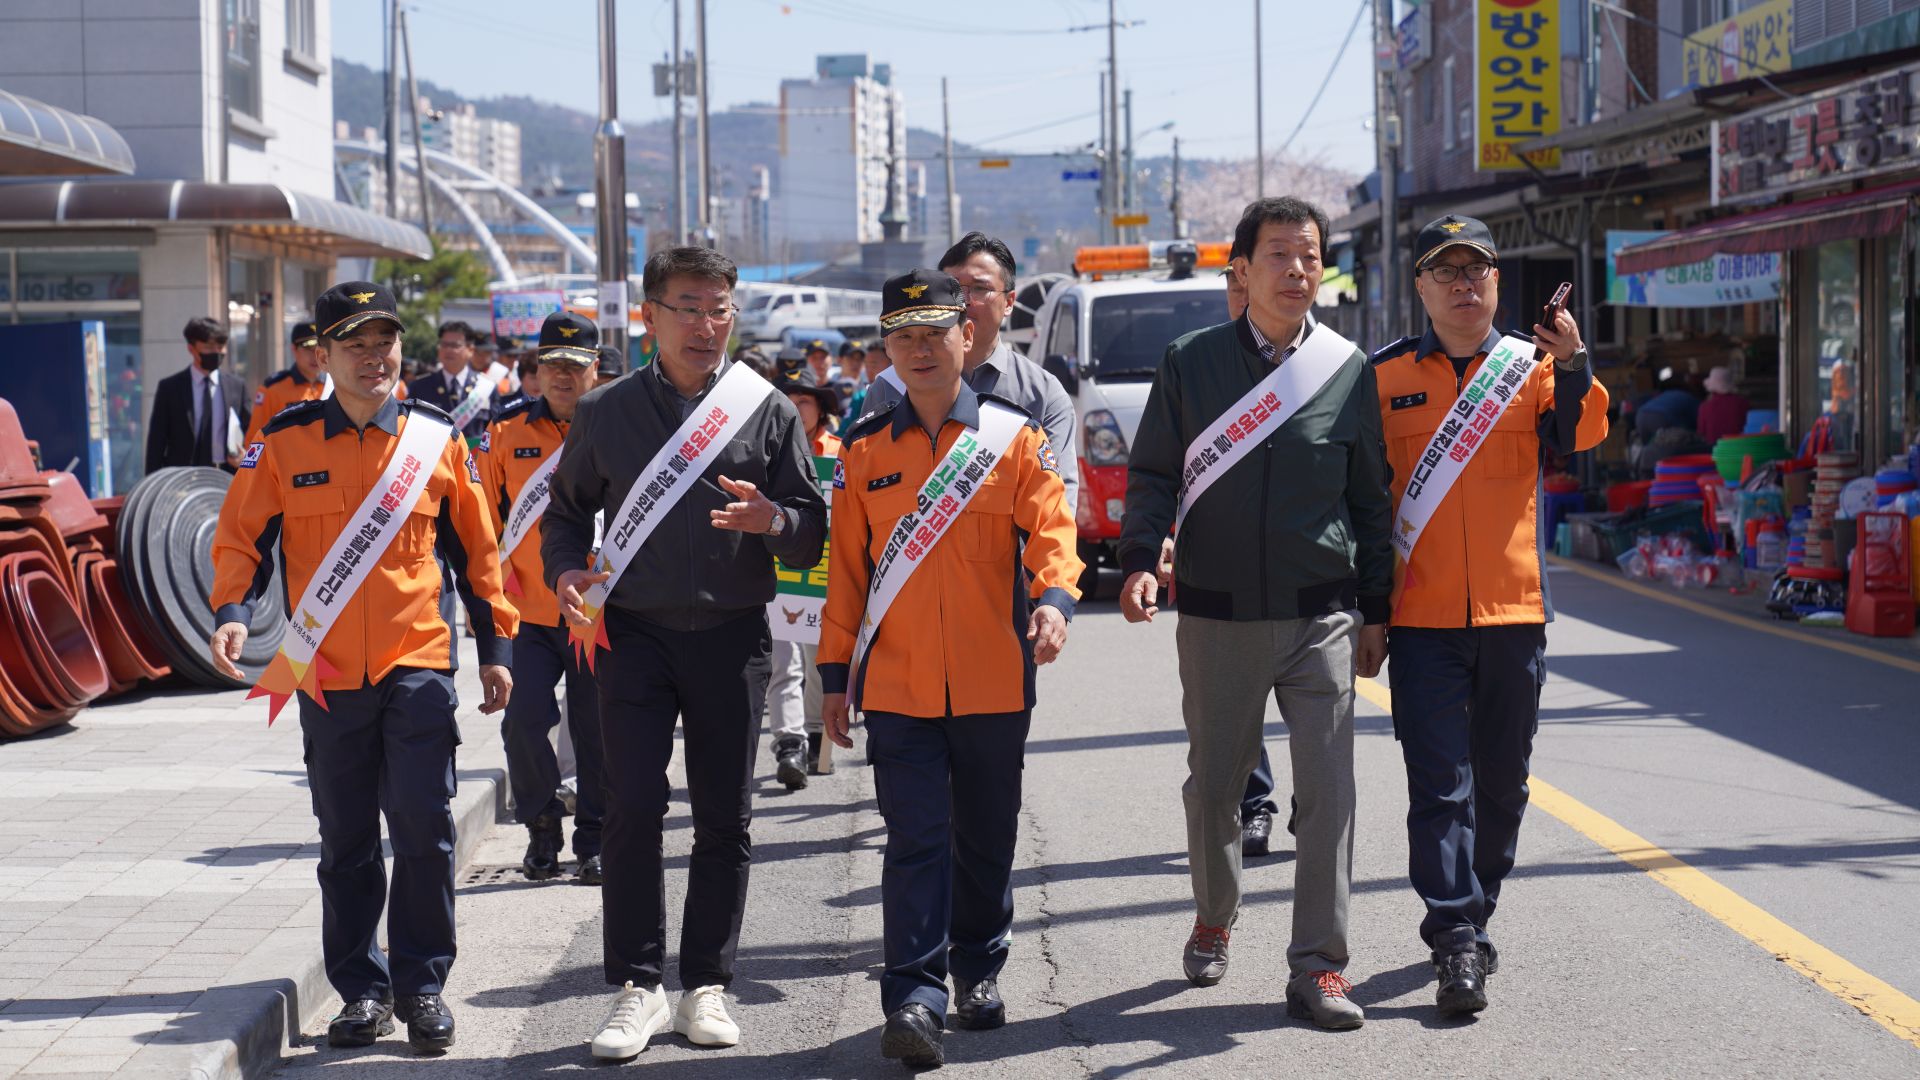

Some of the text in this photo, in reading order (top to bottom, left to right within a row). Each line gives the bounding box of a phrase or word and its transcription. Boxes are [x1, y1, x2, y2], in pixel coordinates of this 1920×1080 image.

[1489, 12, 1550, 138] 방앗간
[1719, 252, 1772, 281] 이용하여
[1213, 391, 1282, 455] 화재예방을
[1406, 418, 1464, 501] 실천입니다
[1449, 399, 1500, 463] 화재예방
[613, 406, 730, 552] 화재예방을 생활화합니다
[315, 454, 422, 606] 화재예방을 생활화합니다
[872, 512, 920, 594] 실천입니다
[903, 495, 960, 562] 화재예방
[292, 620, 317, 649] 보성소방서
